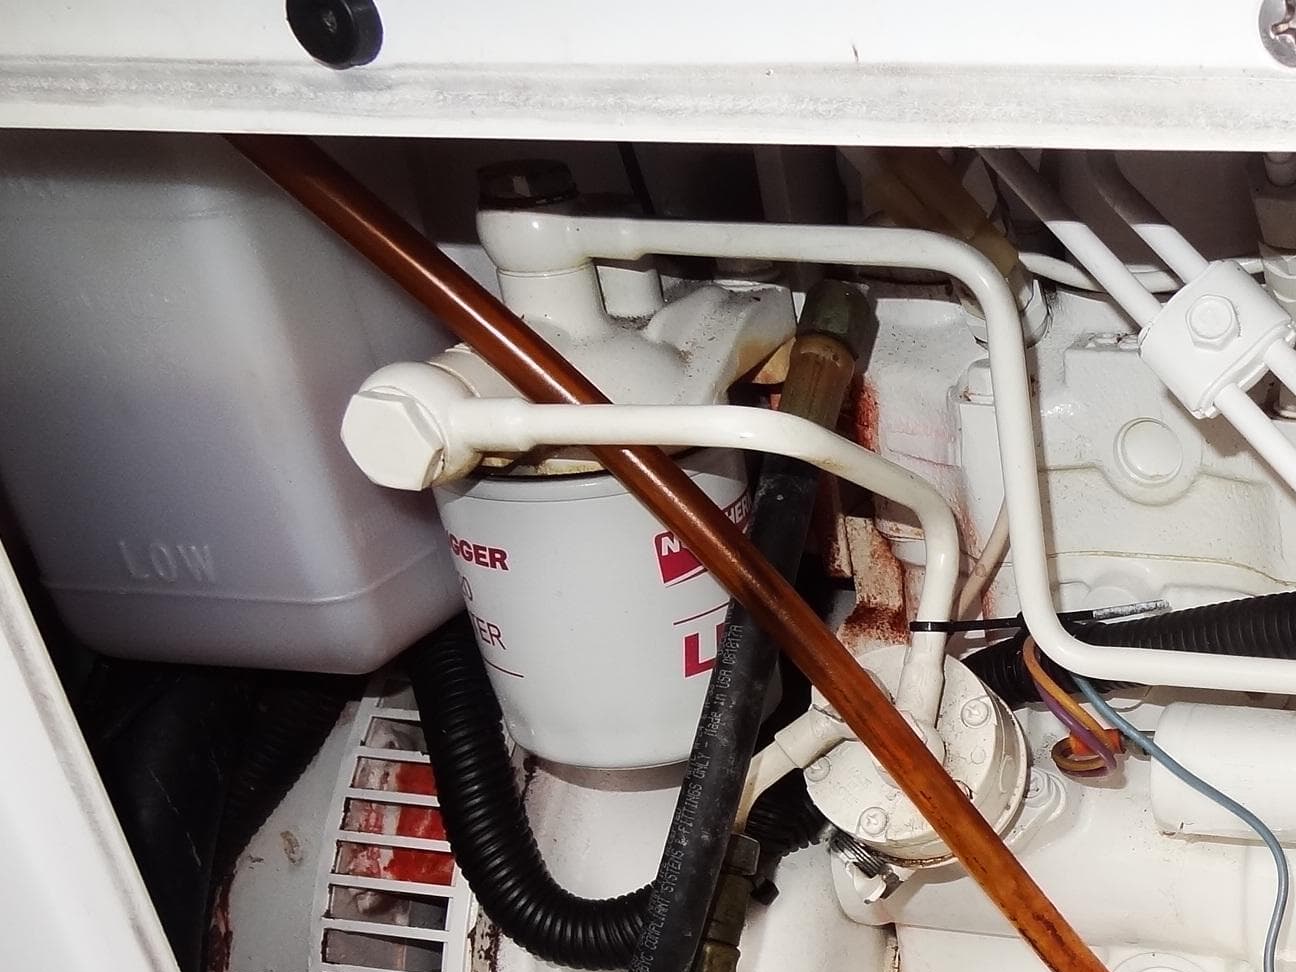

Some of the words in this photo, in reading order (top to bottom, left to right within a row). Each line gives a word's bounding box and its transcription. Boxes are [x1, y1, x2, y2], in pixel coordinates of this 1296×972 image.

[118, 539, 216, 584] LOW
[449, 533, 509, 571] GGER
[470, 611, 506, 650] TER
